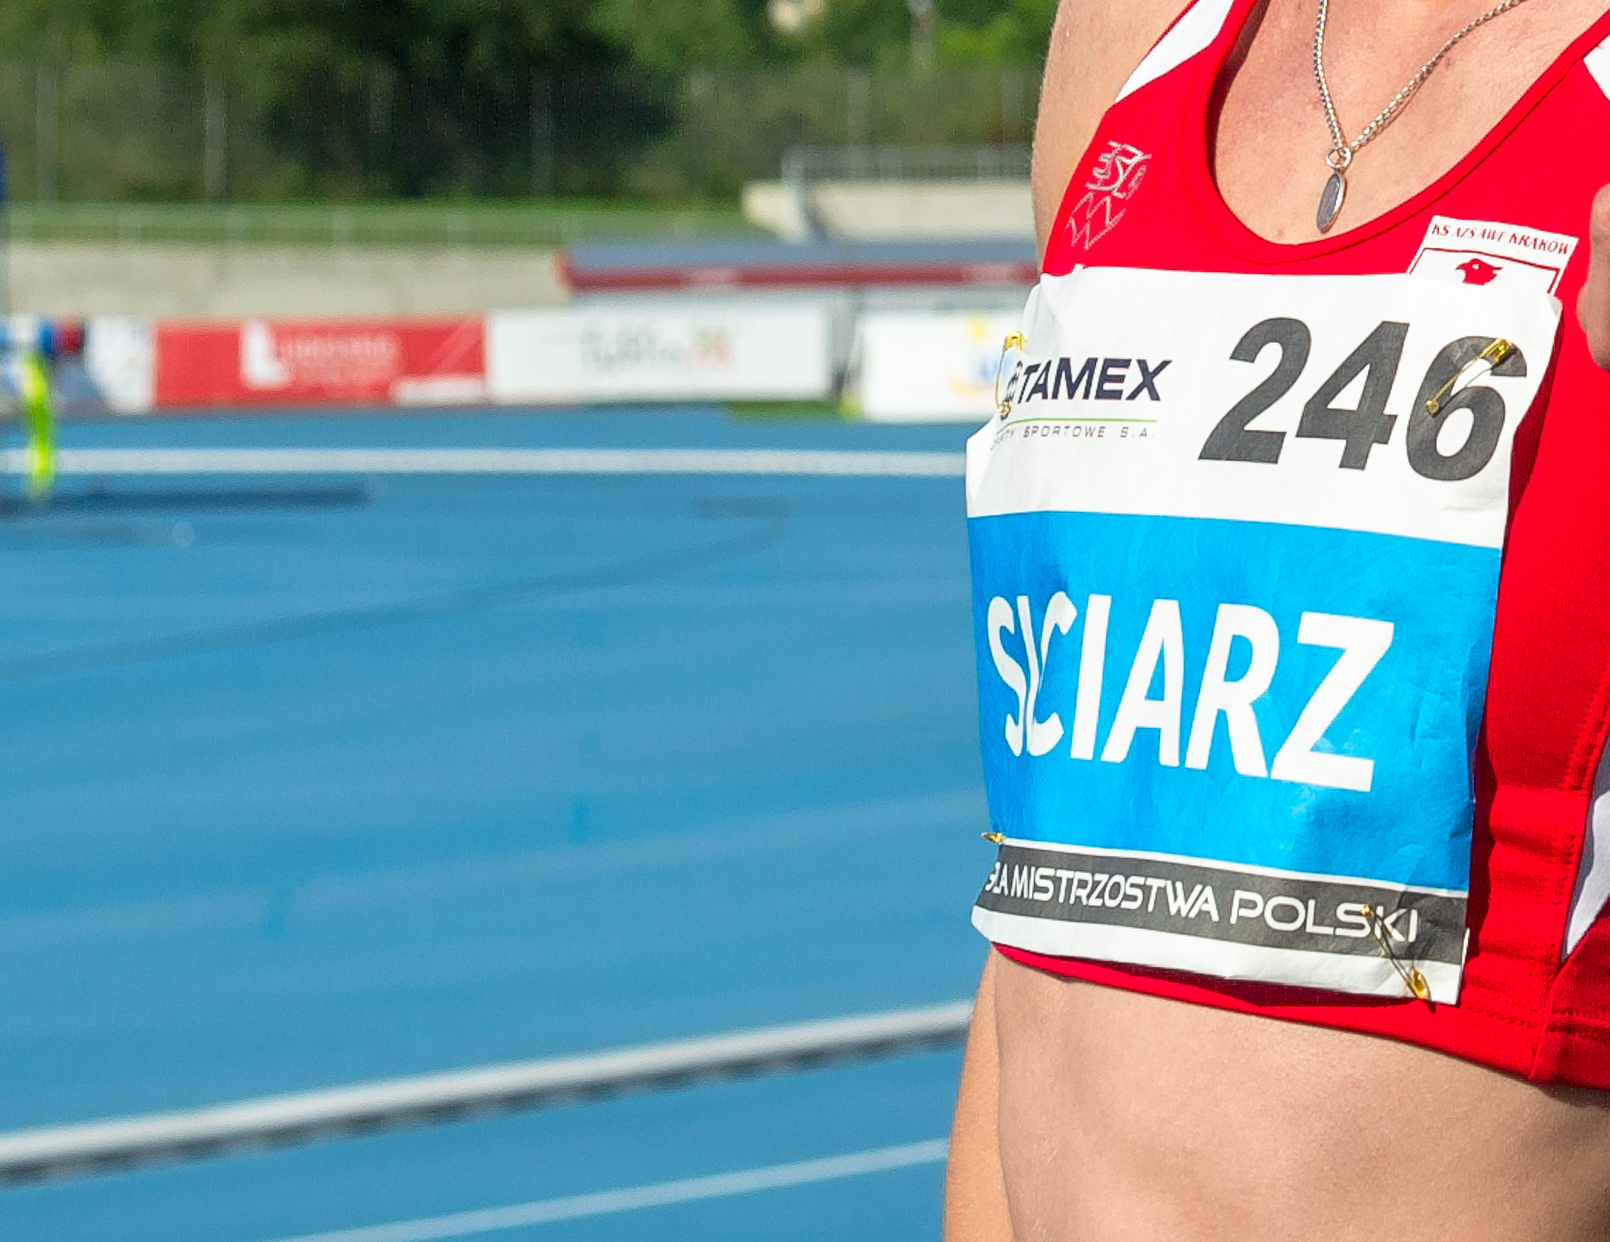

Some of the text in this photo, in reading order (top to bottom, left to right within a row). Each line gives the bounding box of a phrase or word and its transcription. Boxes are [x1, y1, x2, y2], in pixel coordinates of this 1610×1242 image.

[1018, 357, 1172, 404] TAMEX
[1198, 317, 1527, 481] 246
[1023, 425, 1106, 439] SPORTOWE
[1010, 863, 1220, 922] MISTRZOSTWA
[1229, 889, 1418, 942] POLSKI
